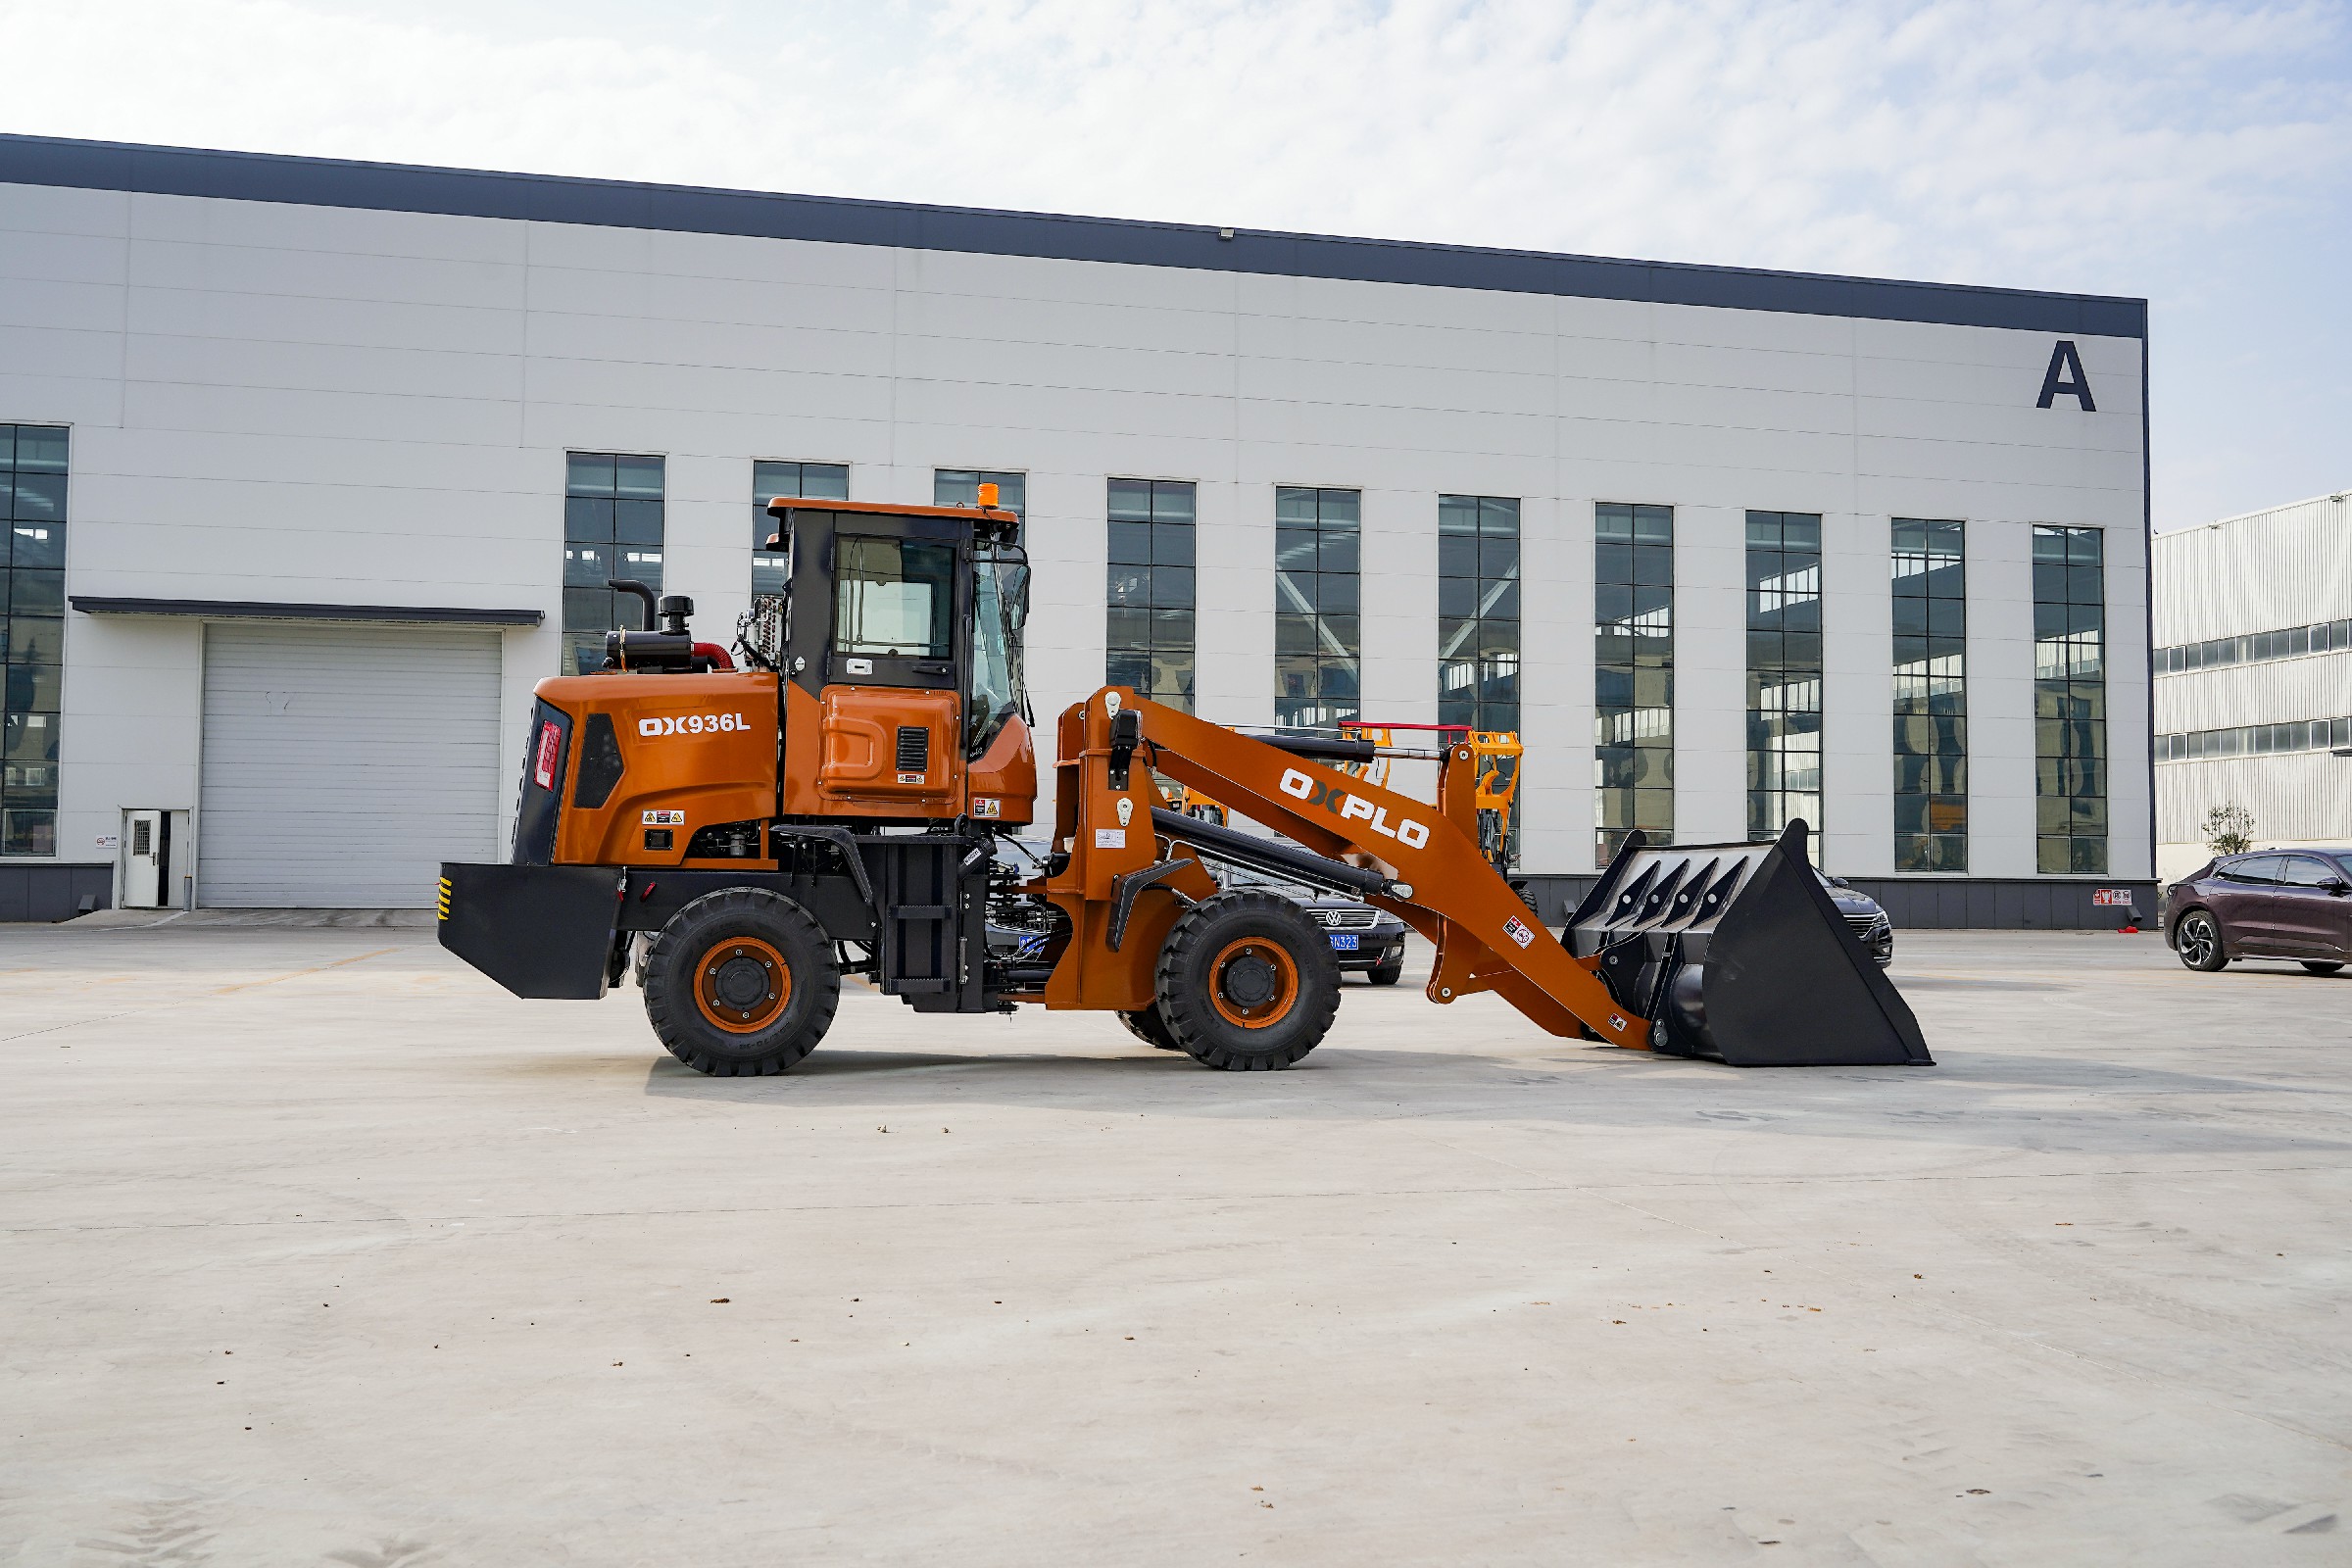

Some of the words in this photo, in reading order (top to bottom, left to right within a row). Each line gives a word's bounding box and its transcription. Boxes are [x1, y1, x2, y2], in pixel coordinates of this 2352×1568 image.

[2036, 340, 2097, 412] A
[638, 712, 752, 737] OX936L
[1279, 767, 1431, 850] OXPLO
